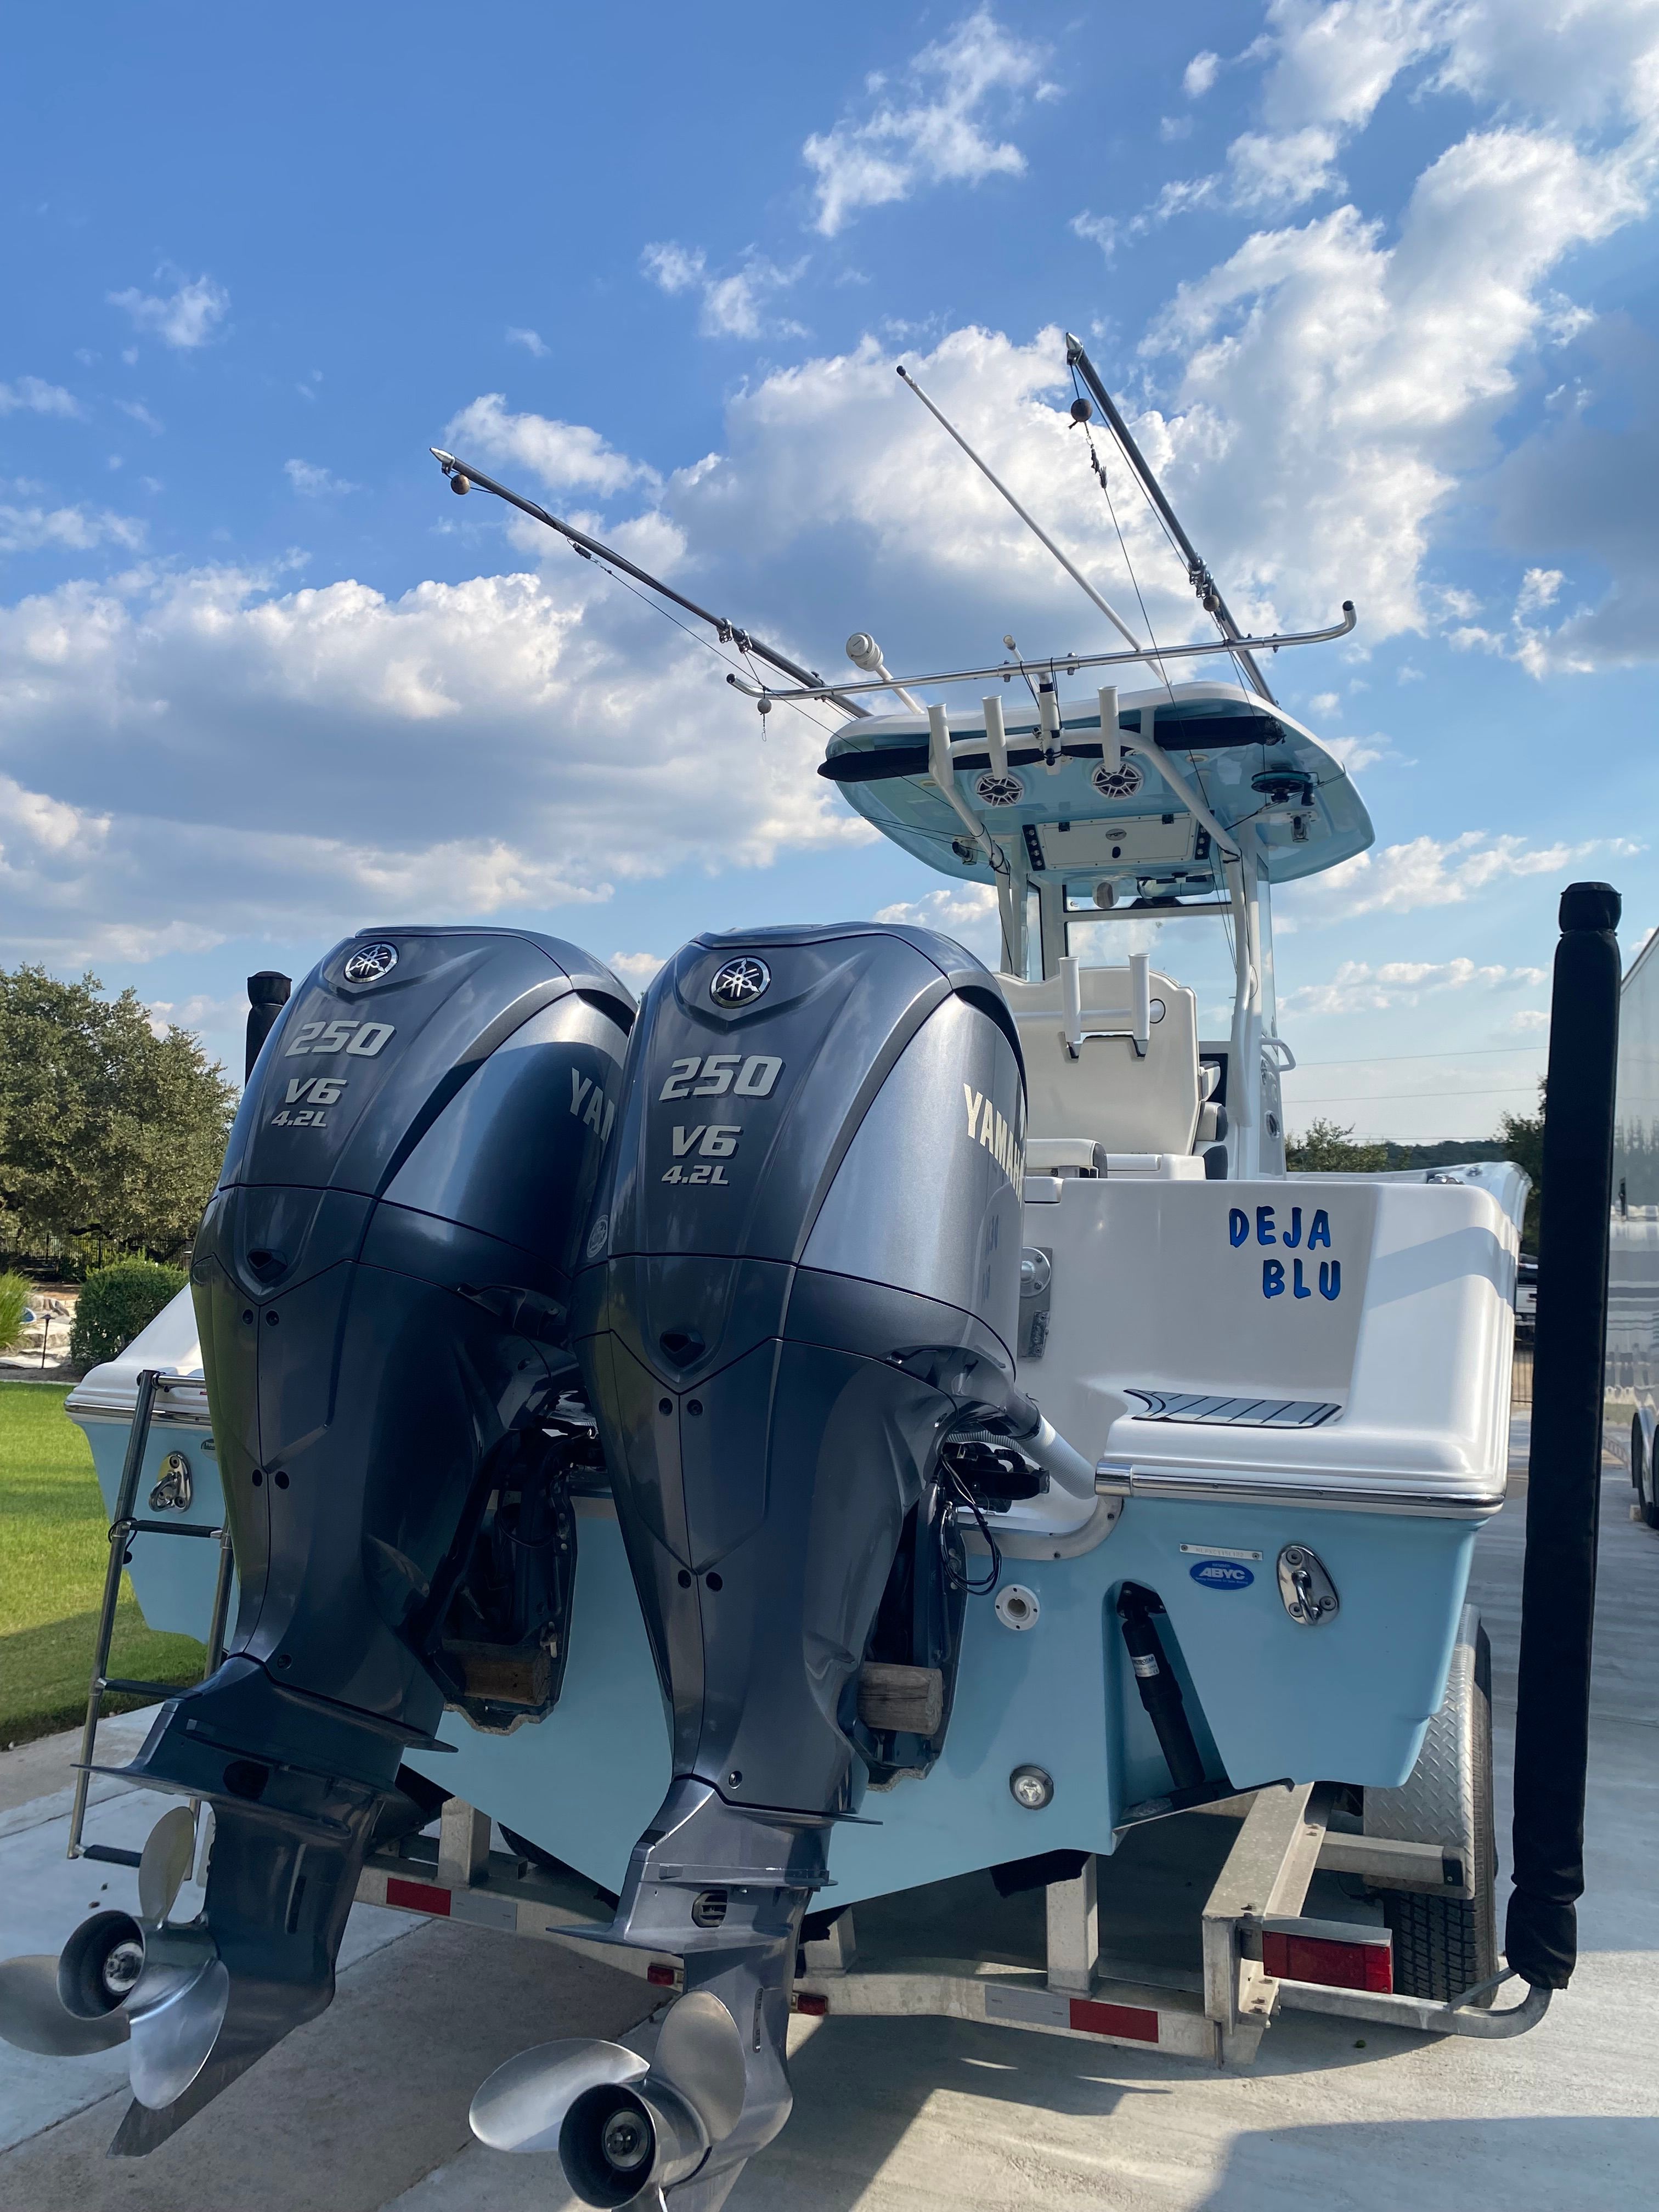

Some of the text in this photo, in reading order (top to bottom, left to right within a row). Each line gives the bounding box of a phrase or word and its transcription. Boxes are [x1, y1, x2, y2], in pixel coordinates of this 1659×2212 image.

[285, 1020, 396, 1057] 250
[285, 1078, 347, 1104] V6
[659, 1054, 783, 1101] 250
[271, 1110, 326, 1127] 4.2L
[673, 1125, 741, 1156] V6
[661, 1165, 729, 1184] 4.2L
[1229, 1206, 1331, 1250] DEJA
[1263, 1258, 1341, 1301] BLU
[1199, 1567, 1245, 1580] ABYC
